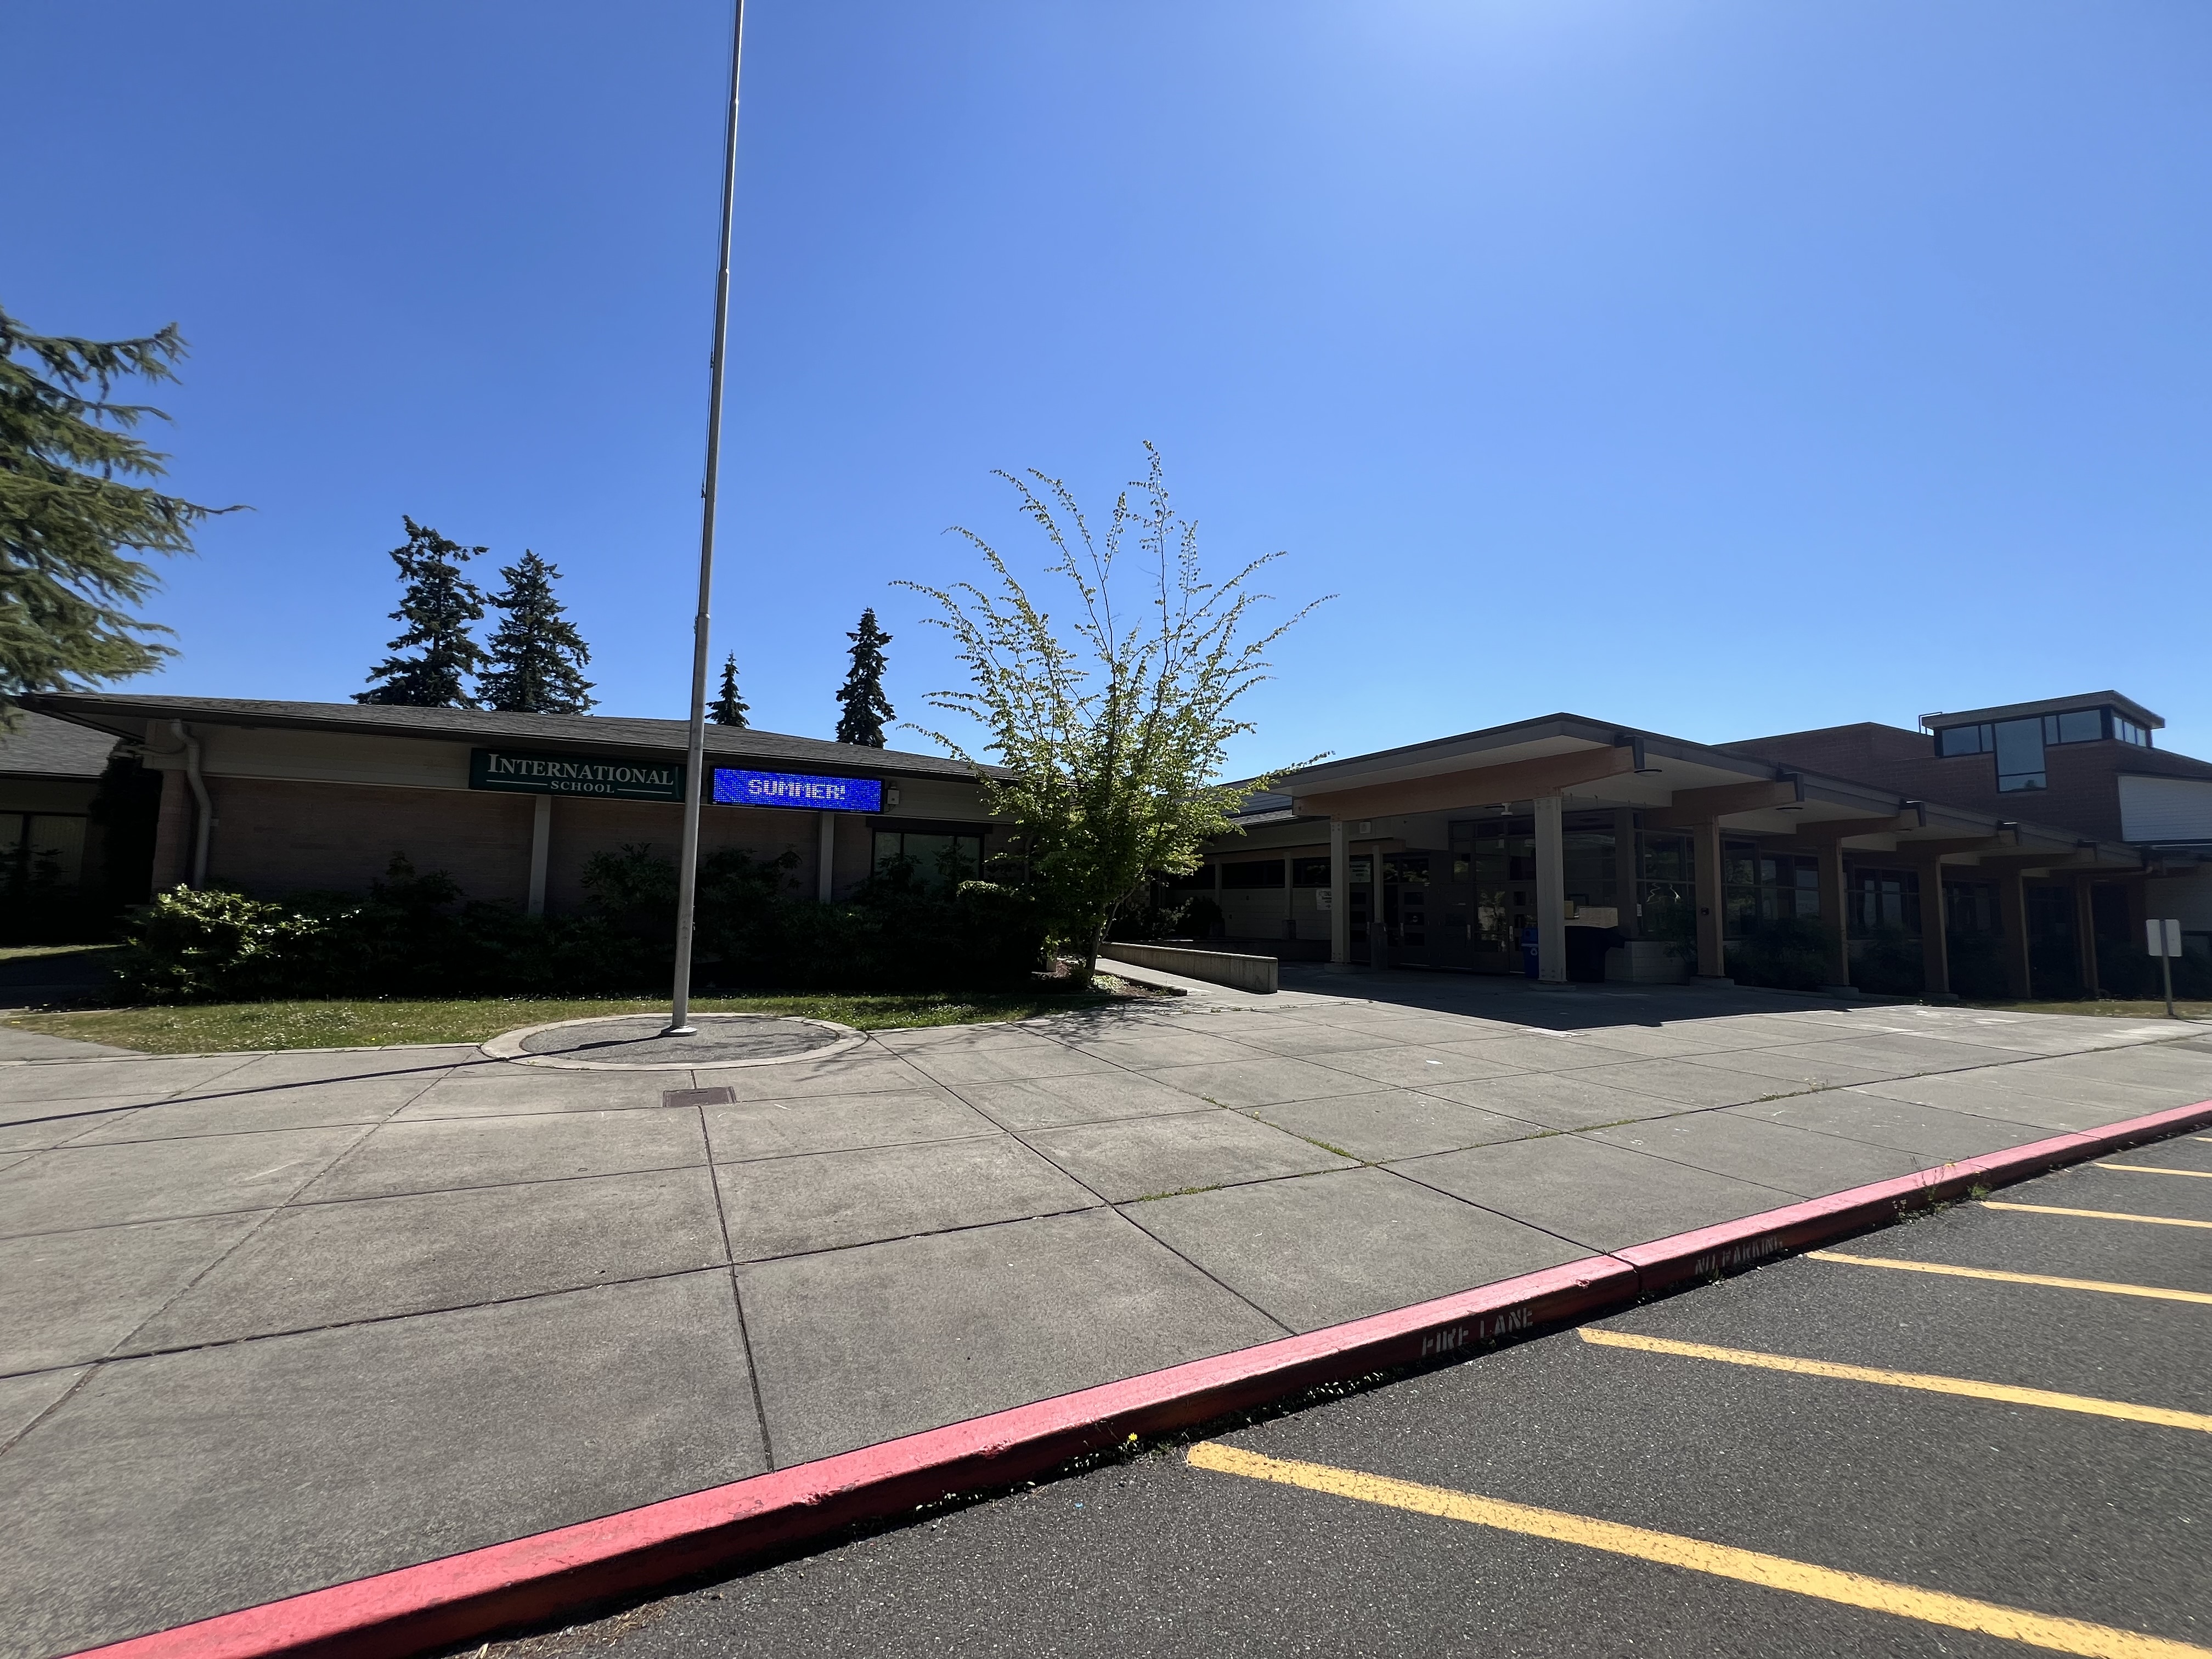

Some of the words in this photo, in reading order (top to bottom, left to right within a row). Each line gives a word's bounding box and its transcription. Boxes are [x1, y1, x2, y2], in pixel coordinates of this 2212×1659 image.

[488, 754, 674, 785] INTERNATIONAL
[551, 781, 614, 793] SCHOOL
[748, 780, 845, 800] SUMMER!
[1422, 1326, 1469, 1356] FIRE
[1480, 1307, 1533, 1339] LANE
